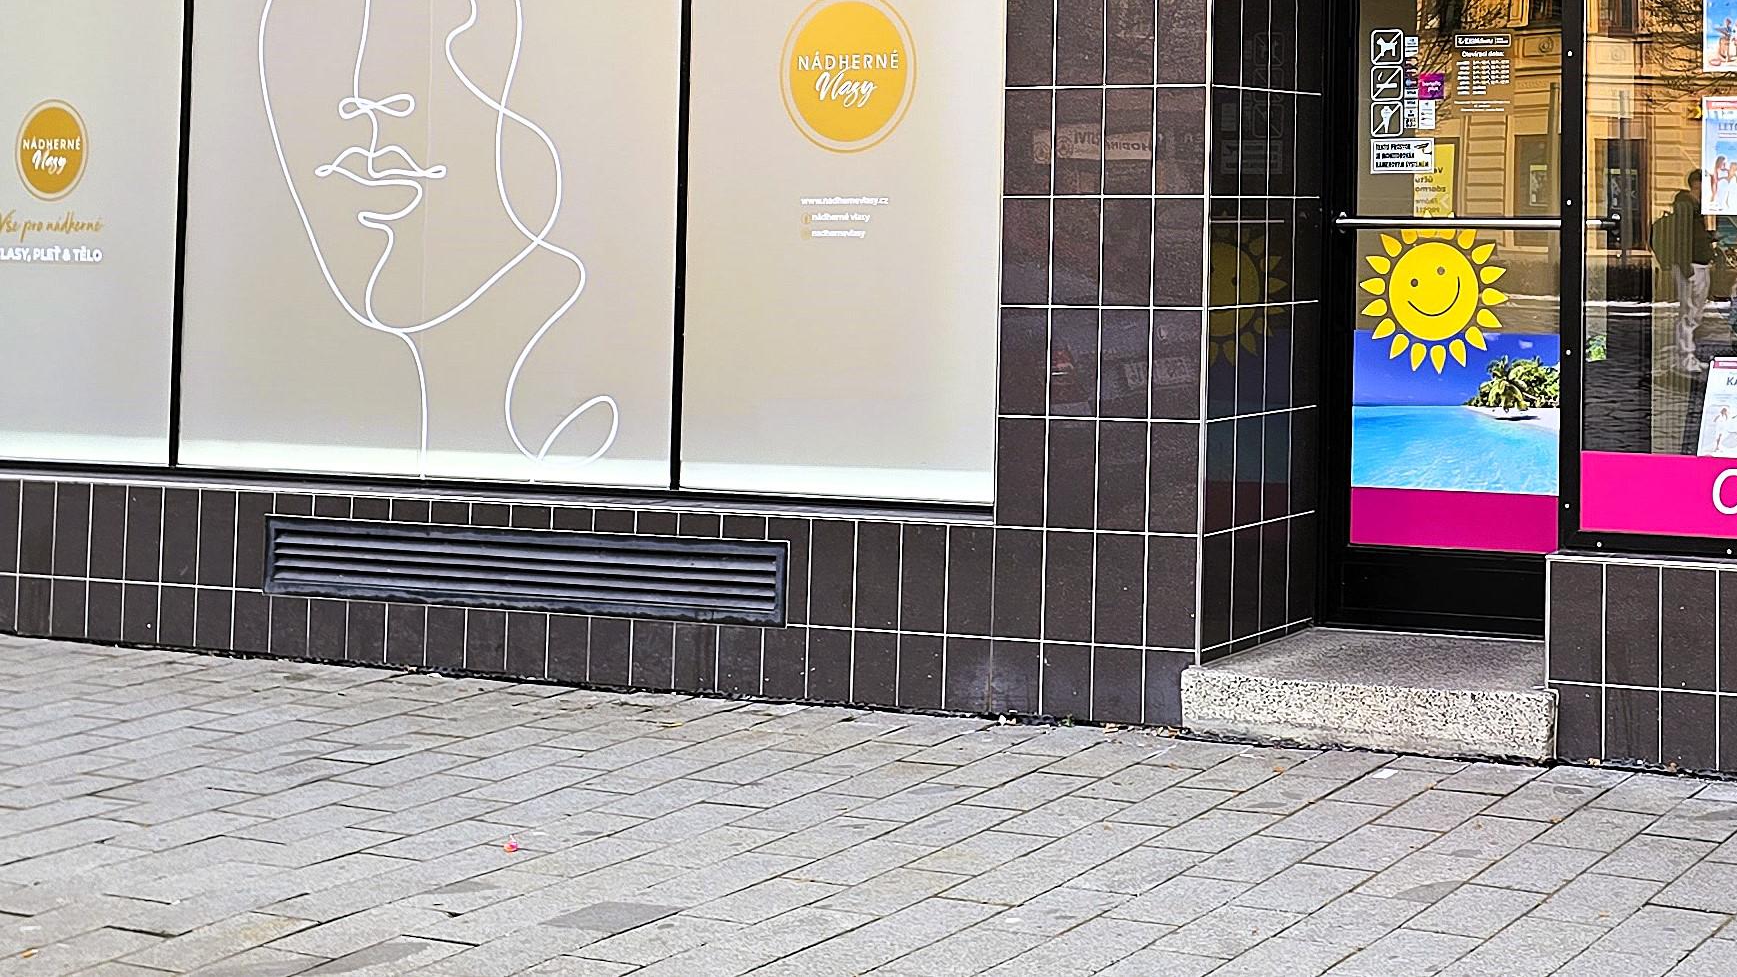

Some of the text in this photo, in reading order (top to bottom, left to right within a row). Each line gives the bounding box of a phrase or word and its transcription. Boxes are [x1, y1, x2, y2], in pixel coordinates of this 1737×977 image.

[798, 50, 900, 71] NÁDHERNÉ
[815, 66, 878, 108] Vlasy
[22, 136, 82, 151] NÁDHERNÉ
[32, 150, 68, 175] Vlasy
[20, 220, 44, 243] pro
[62, 248, 71, 262] &
[73, 245, 103, 263] TĚLO
